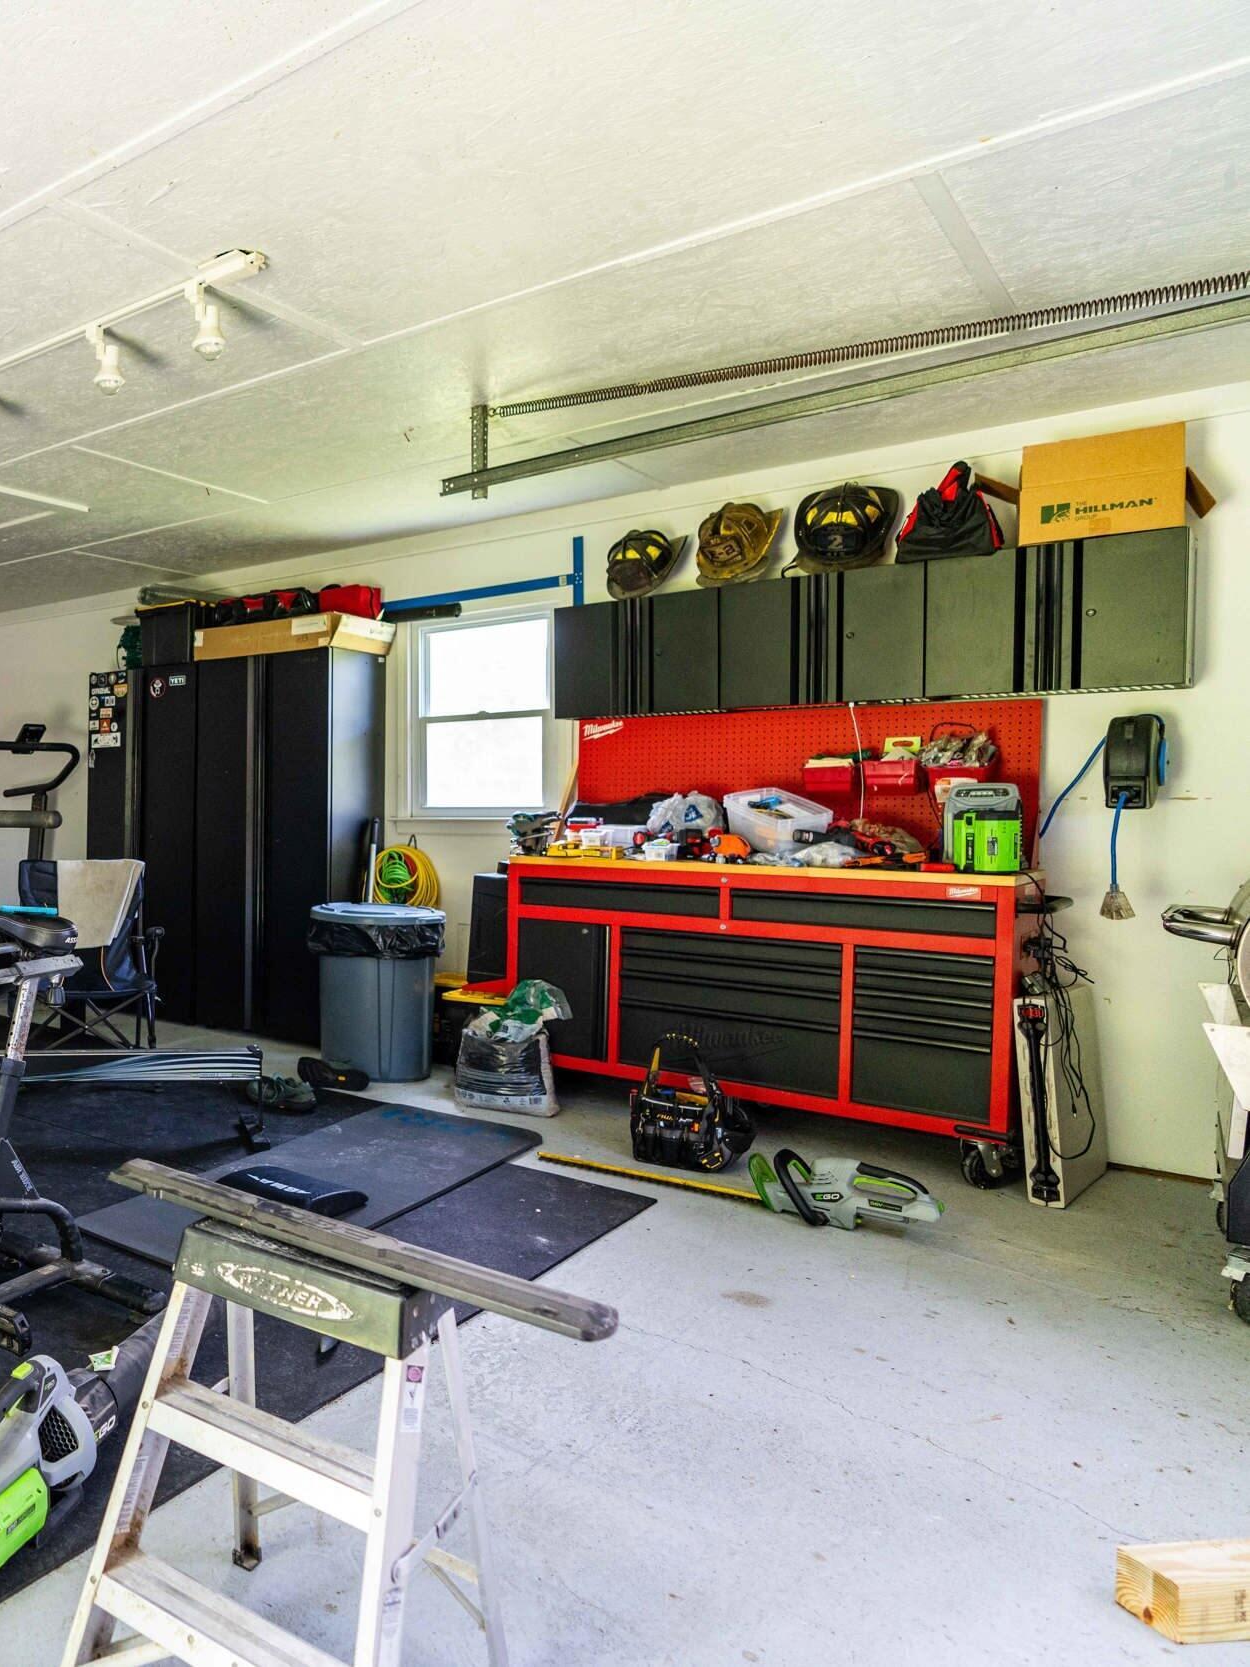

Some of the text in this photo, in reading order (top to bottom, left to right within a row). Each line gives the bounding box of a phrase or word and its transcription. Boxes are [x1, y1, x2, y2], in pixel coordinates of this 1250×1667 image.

[1075, 498, 1153, 515] HILLMAN
[827, 535, 844, 550] 2
[583, 720, 624, 737] Milwaukee
